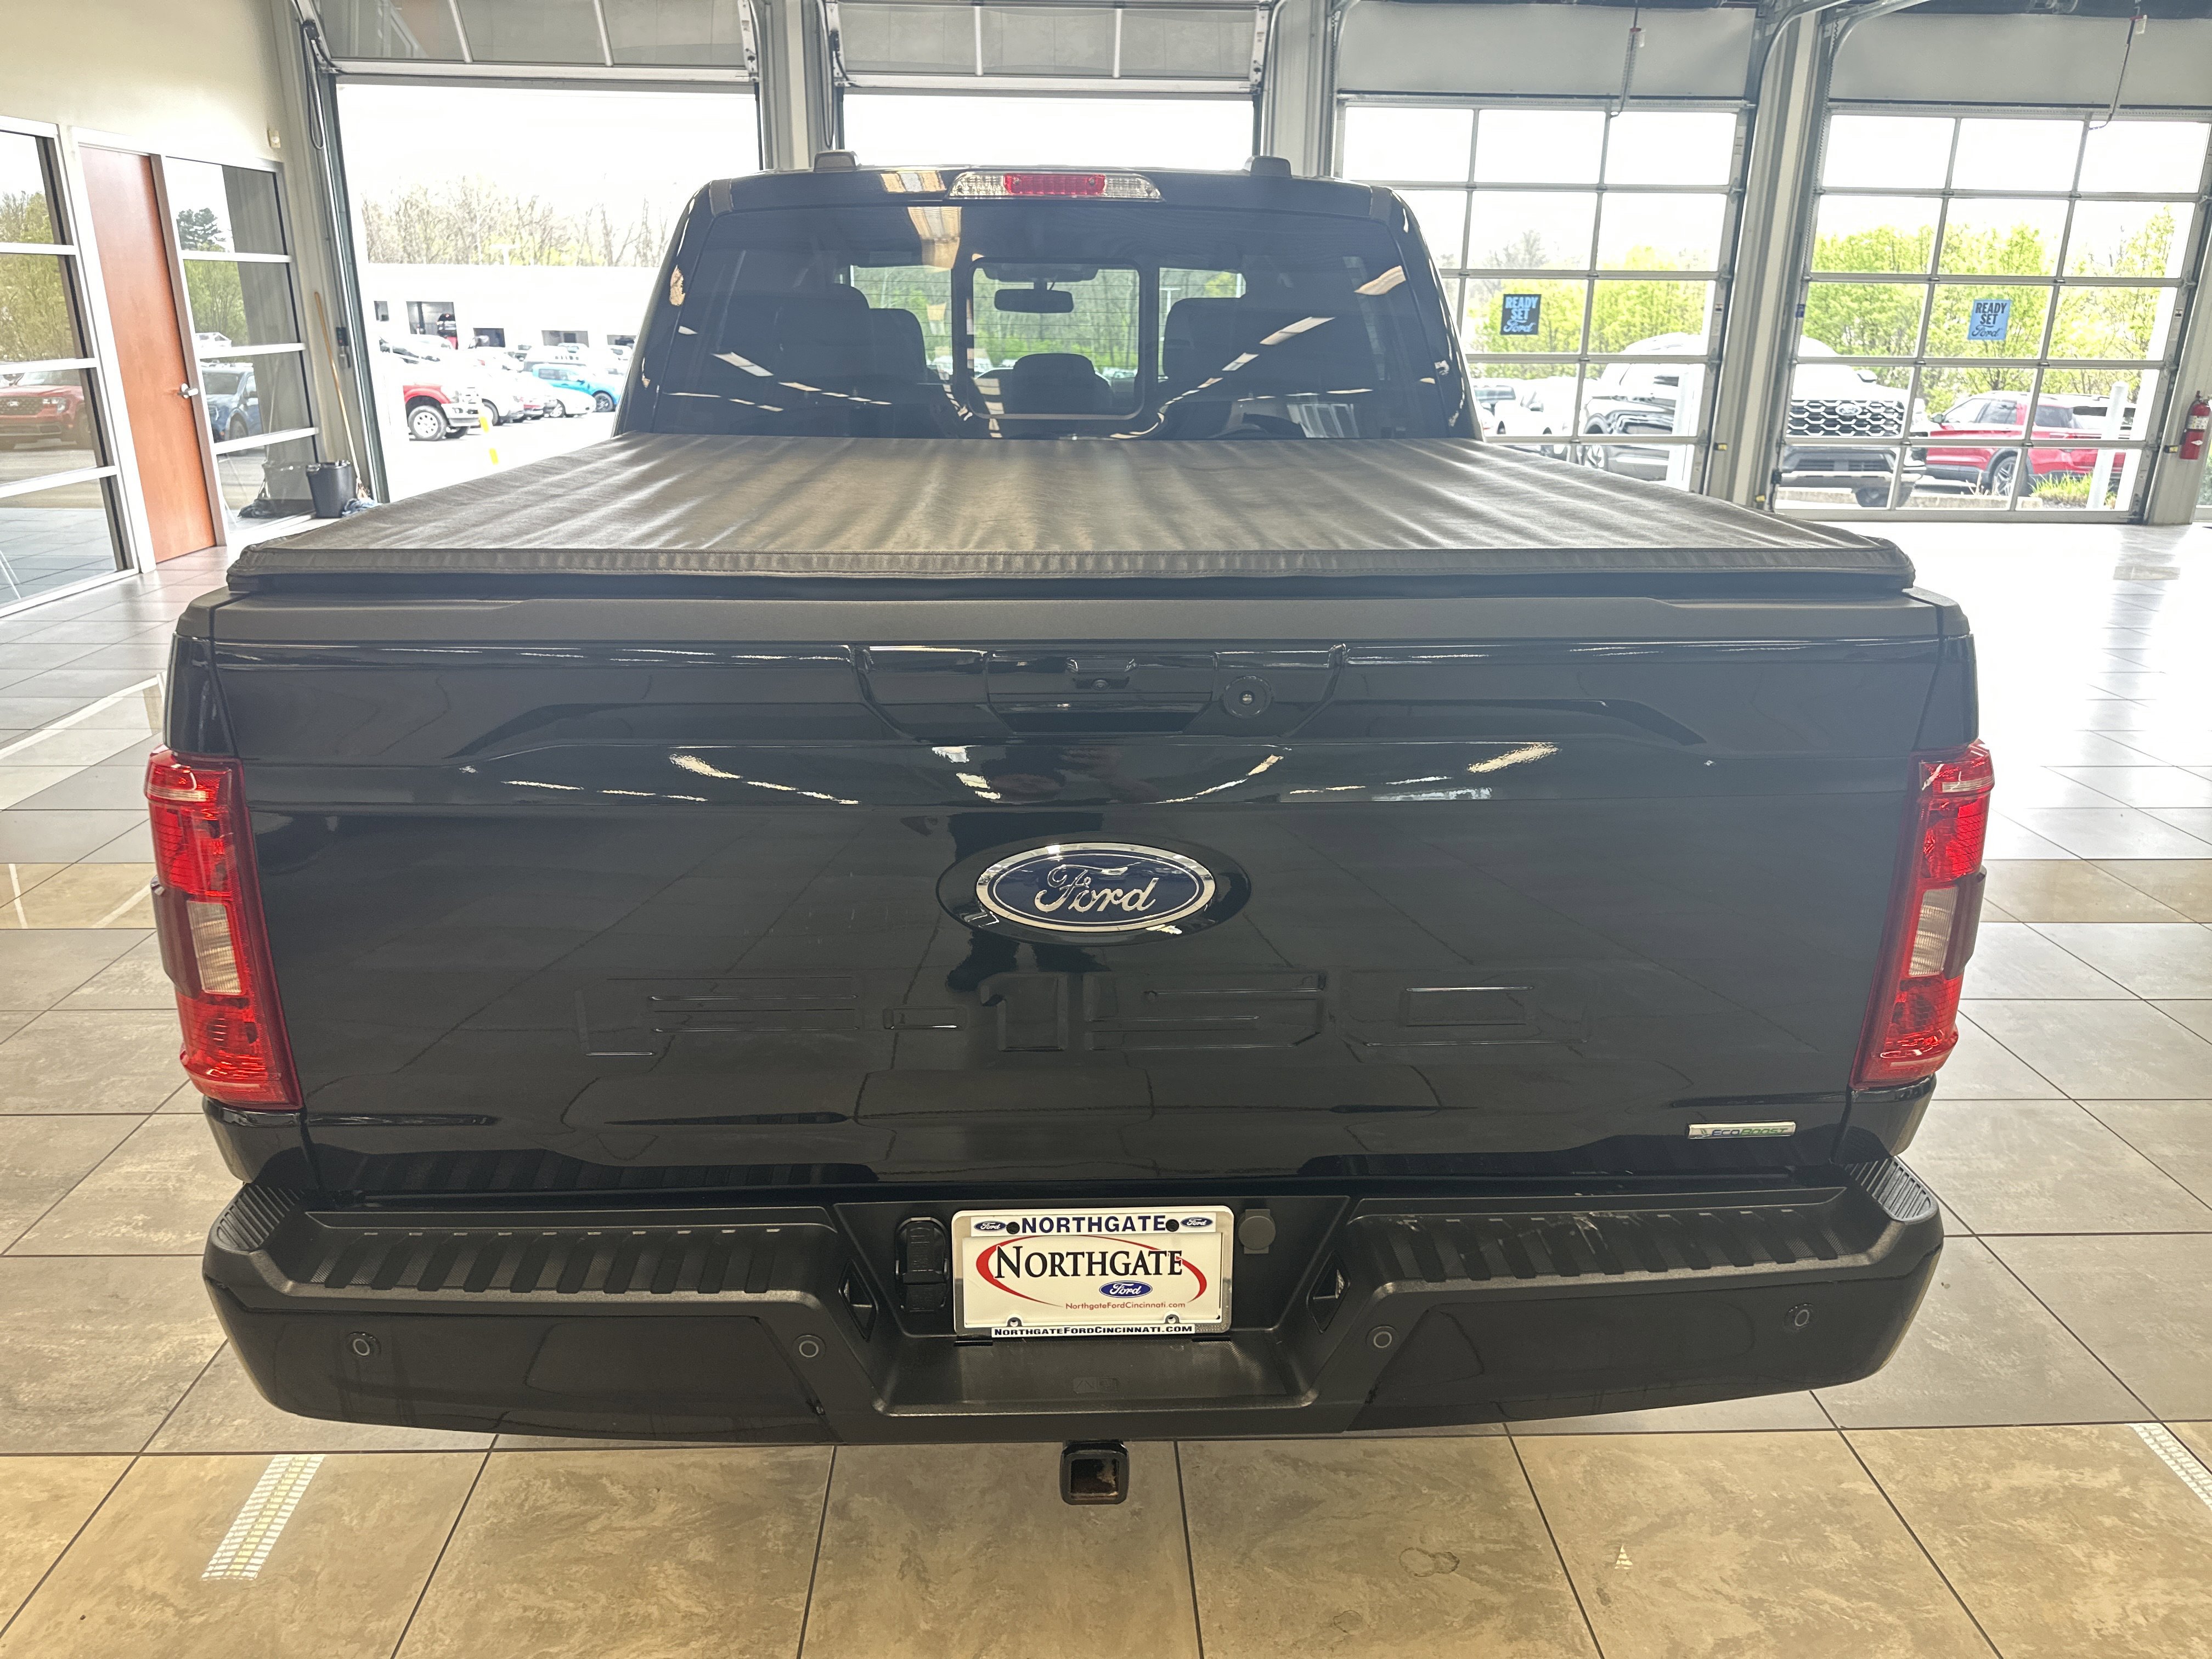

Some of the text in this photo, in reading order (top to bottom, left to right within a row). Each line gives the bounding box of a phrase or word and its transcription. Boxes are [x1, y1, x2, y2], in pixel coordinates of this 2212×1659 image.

[1505, 297, 1538, 308] READY
[1976, 302, 2007, 313] READY
[1511, 308, 1530, 320] SET
[1980, 314, 1997, 325] SET
[1503, 319, 1536, 332] Ford
[1972, 325, 2001, 337] Ford
[1034, 861, 1159, 913] Ford
[980, 1222, 1001, 1230] Ford
[1022, 1215, 1166, 1233] NORTHGATE
[1186, 1218, 1207, 1226] Ford
[994, 1245, 1183, 1279] NORTHGATE
[1109, 1283, 1142, 1295] Ford
[1065, 1301, 1186, 1310] NorthgateFordCincinnati.com
